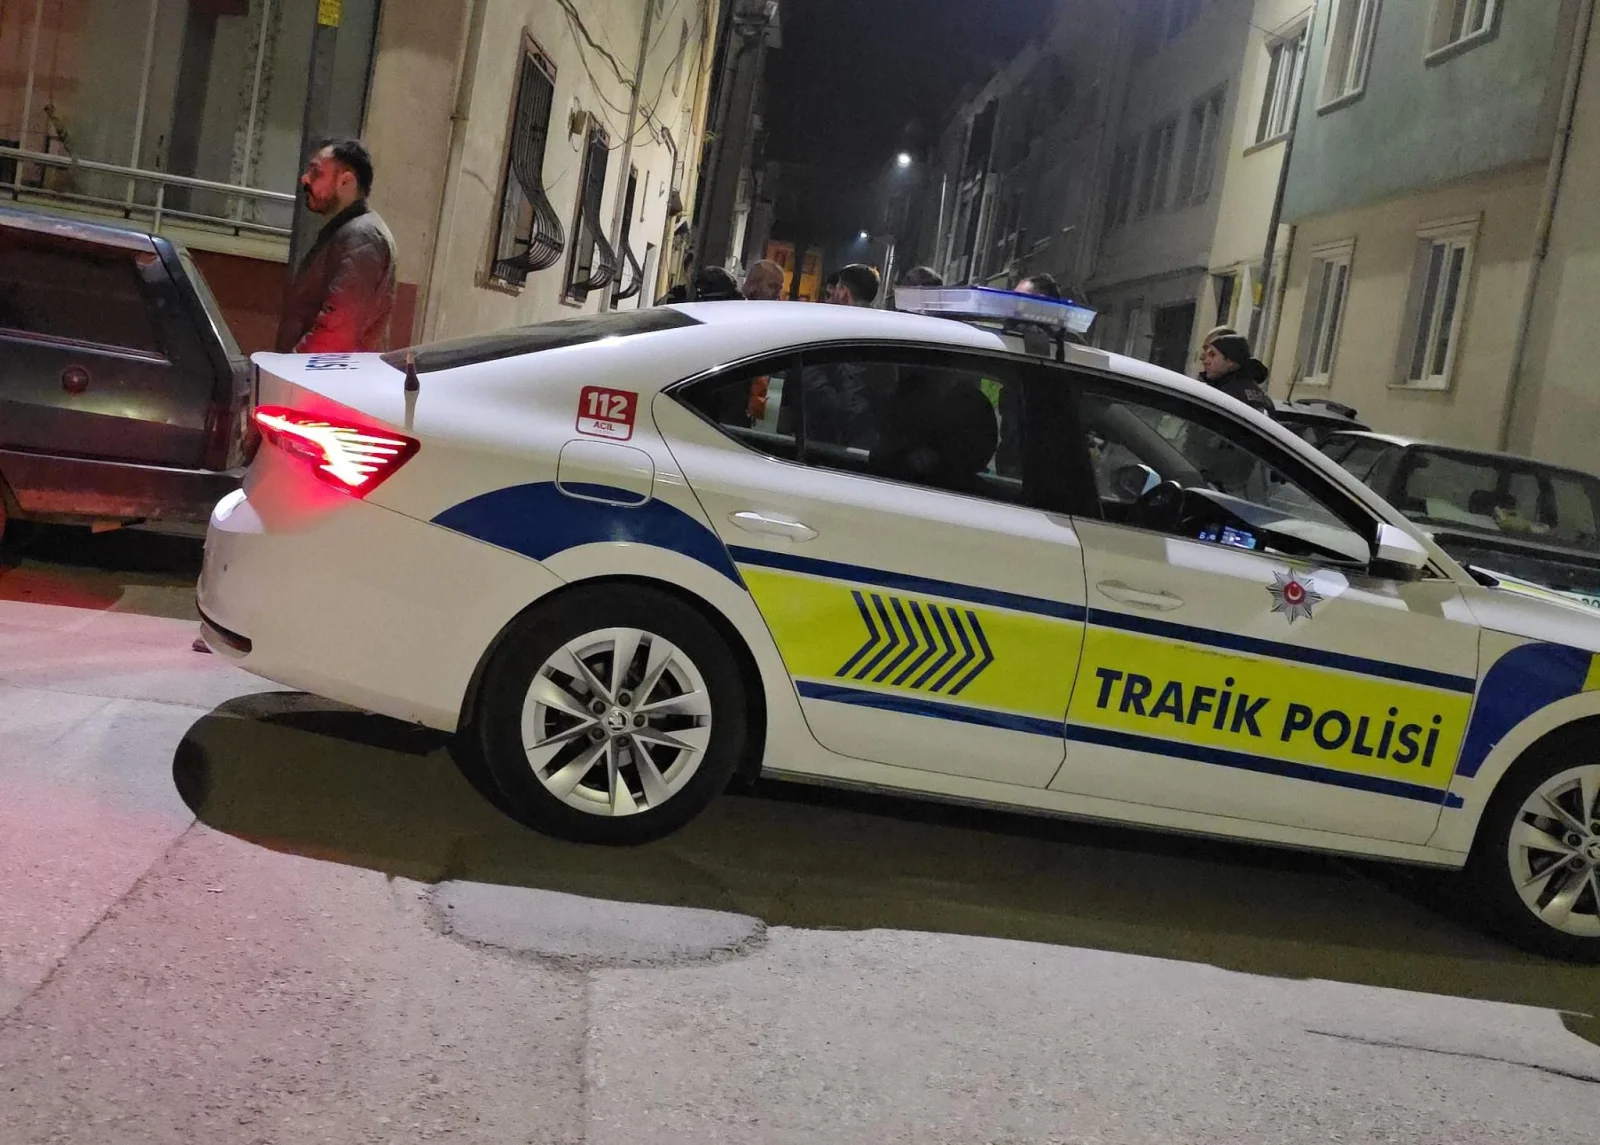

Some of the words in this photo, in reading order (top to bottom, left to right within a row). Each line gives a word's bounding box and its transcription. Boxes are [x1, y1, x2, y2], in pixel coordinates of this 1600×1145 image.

[588, 391, 628, 420] 112
[1096, 667, 1271, 737] TRAFİK
[1280, 702, 1443, 768] POLİSİ
